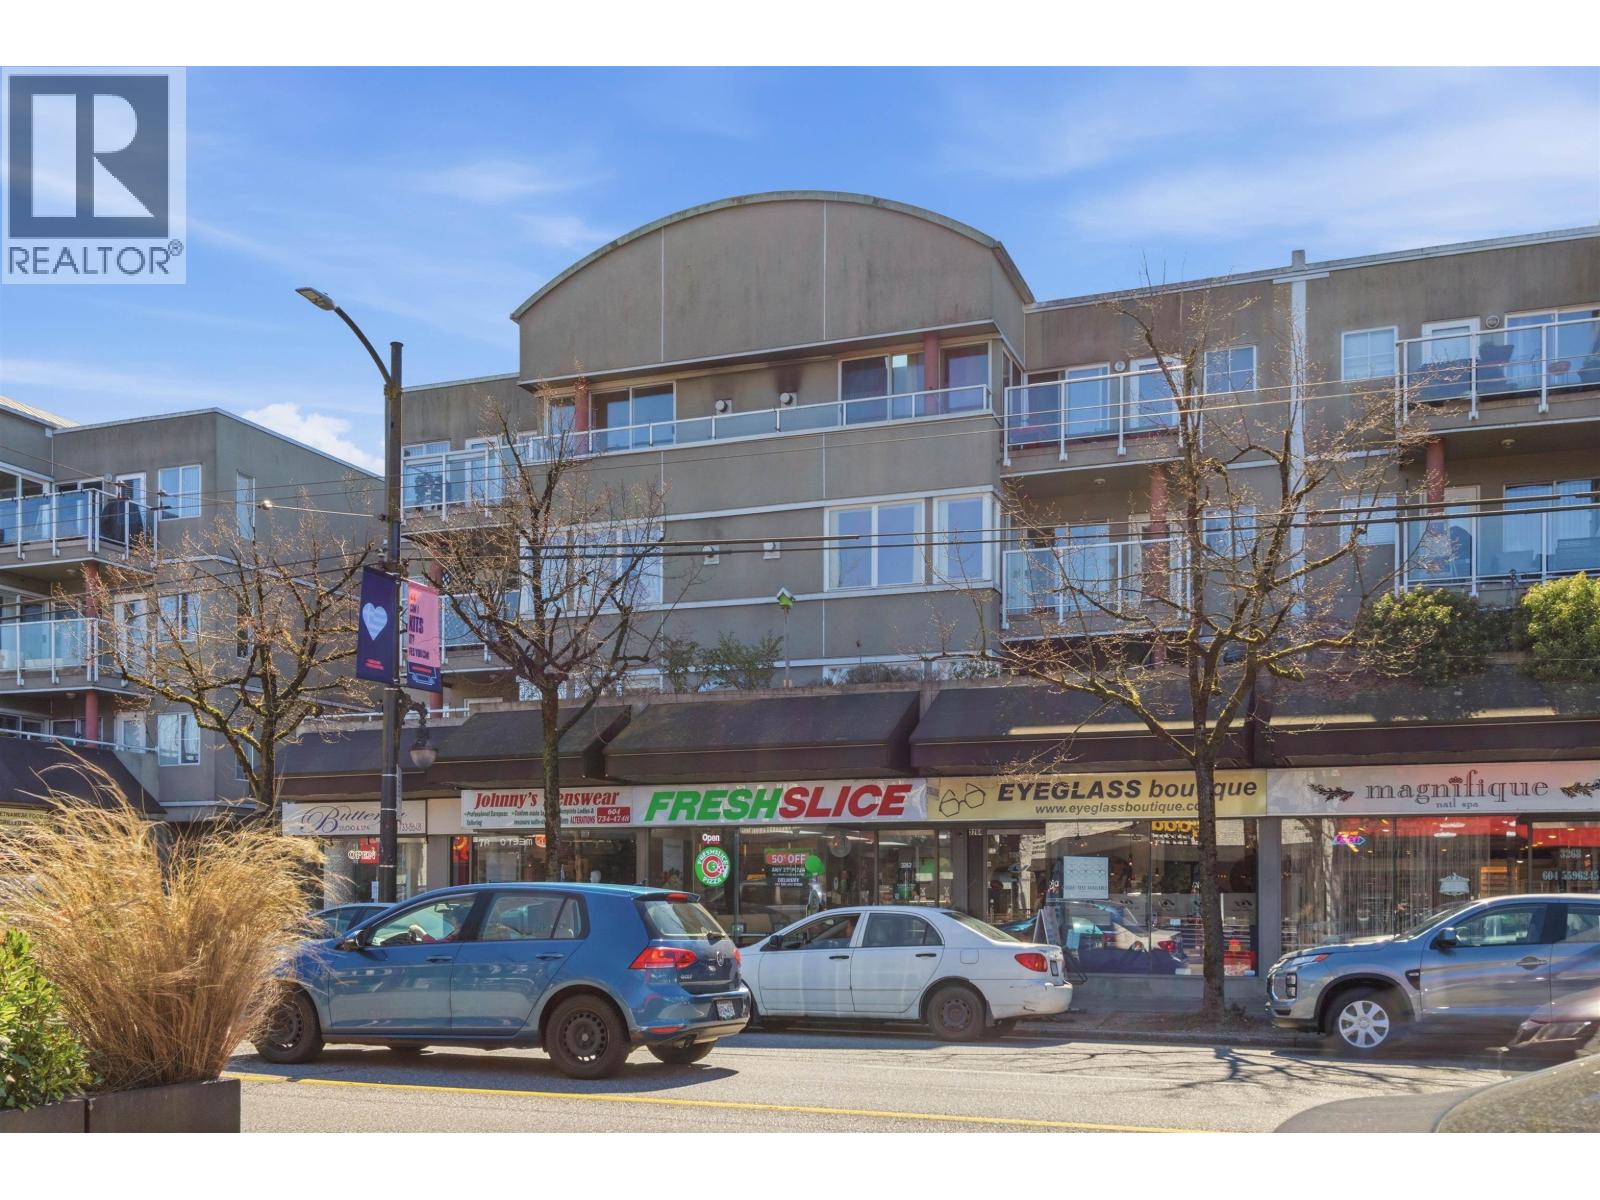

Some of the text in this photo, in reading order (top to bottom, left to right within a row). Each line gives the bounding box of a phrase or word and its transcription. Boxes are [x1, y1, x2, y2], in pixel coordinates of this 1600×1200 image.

[409, 615, 424, 634] KITS
[998, 779, 1257, 802] EYEGLASS bouque
[1366, 770, 1549, 805] magnifique
[474, 791, 620, 809] Johnny's enswear
[645, 784, 912, 821] FRESHSLICE
[1035, 800, 1201, 816] www.eyeglassboutique.co
[1436, 799, 1479, 810] nail spa
[702, 833, 720, 844] Open
[788, 854, 806, 864] OFF
